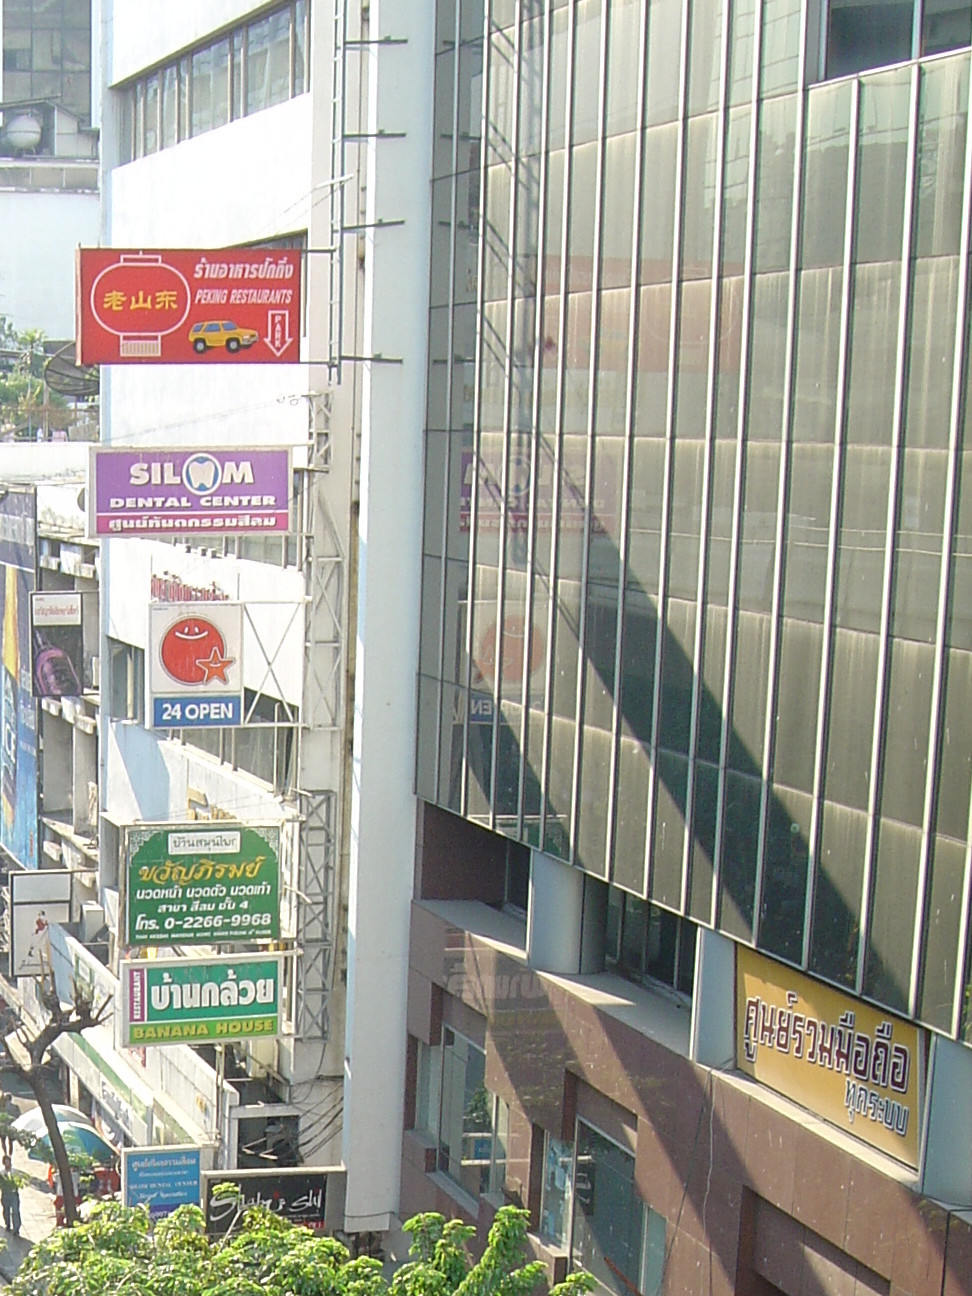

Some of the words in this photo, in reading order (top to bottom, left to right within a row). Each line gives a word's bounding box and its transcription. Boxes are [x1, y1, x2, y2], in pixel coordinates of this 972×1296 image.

[103, 290, 178, 311] 老山东
[195, 289, 228, 304] PEKING
[229, 289, 293, 304] RESTAURANTS
[129, 453, 254, 496] SILOM
[109, 497, 192, 509] DENTAL
[199, 495, 276, 508] CENTER
[162, 703, 182, 720] 24
[184, 703, 233, 719] OPEN
[164, 913, 272, 930] 0-2266-9968
[151, 969, 275, 1011] บ้านกล้วย
[133, 1024, 209, 1040] BANANA
[216, 1020, 274, 1035] HOUSE
[743, 991, 911, 1093] ศูนย์รวมมือถือ
[844, 1078, 910, 1136] ทุกระบบ
